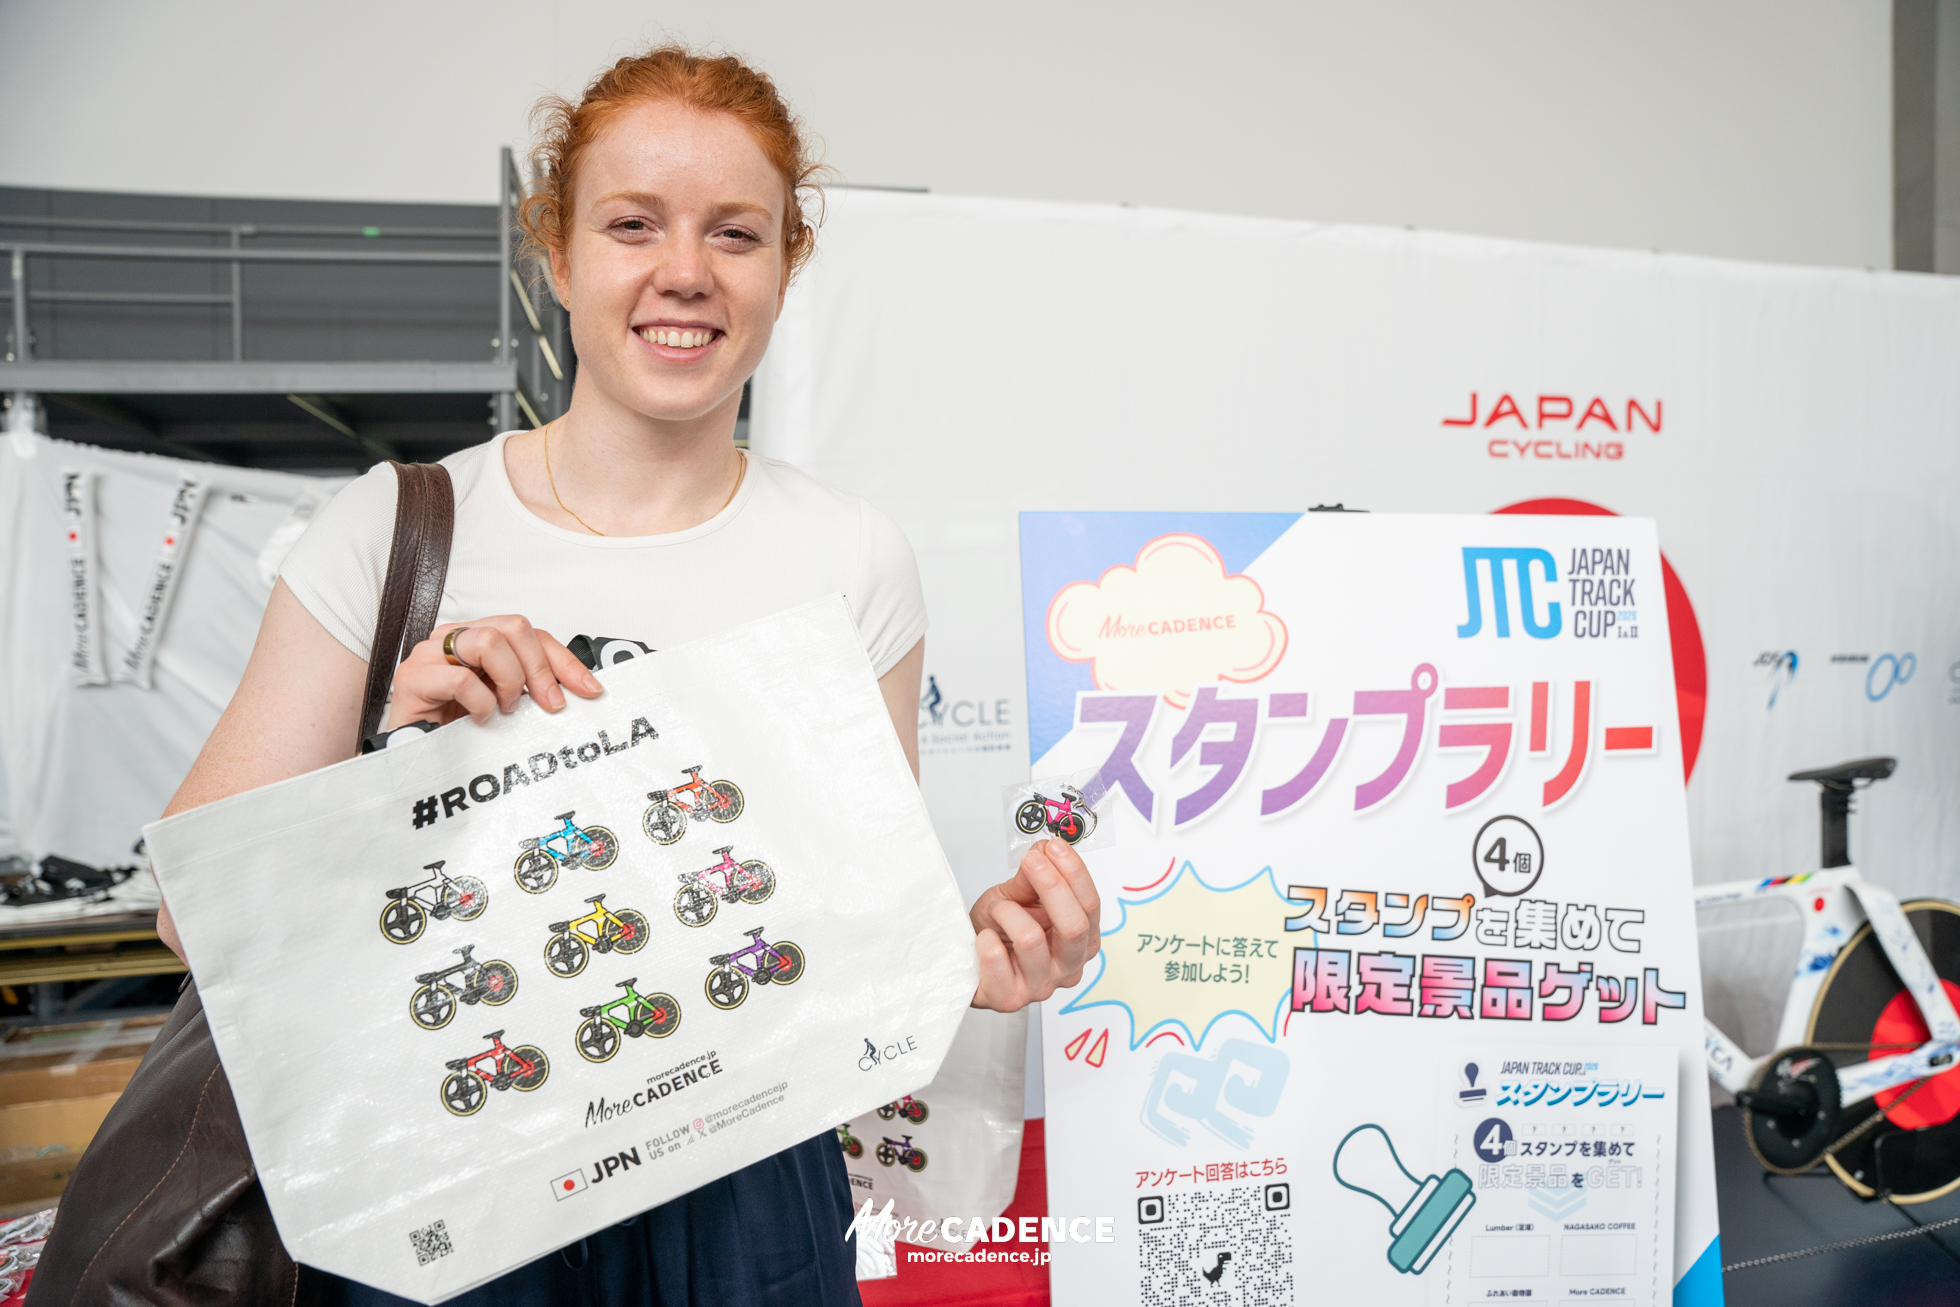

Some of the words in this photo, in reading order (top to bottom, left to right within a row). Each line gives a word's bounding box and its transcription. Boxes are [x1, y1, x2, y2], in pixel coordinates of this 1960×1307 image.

[1441, 392, 1662, 433] JAPAN
[1488, 438, 1624, 461] CYCLING
[1567, 548, 1630, 576] JAPAN
[1457, 547, 1563, 639] JTC
[1567, 578, 1636, 607] TRACK
[1574, 610, 1616, 638] CUP
[1079, 662, 1654, 827] スタンプラリー
[412, 717, 660, 830] #ROADtoLA
[1483, 837, 1532, 874] 4個
[1284, 884, 1645, 954] スタンプを集めて
[1136, 933, 1279, 959] アンケートに答えて
[1290, 946, 1686, 1026] 限定景品ゲット
[646, 1049, 717, 1085] morecadence.jp
[858, 1035, 918, 1071] CYCLE
[1499, 1061, 1529, 1075] JAPAN
[1531, 1062, 1562, 1075] TRACK
[1494, 1078, 1665, 1107] スタンプラリー
[645, 1124, 690, 1150] FOLLOW
[704, 1081, 789, 1124] @morecadencejp
[649, 1148, 665, 1160] US
[668, 1142, 682, 1153] on
[708, 1094, 785, 1135] @MoreCadence
[591, 1146, 642, 1184] JPN
[1520, 1140, 1636, 1157] スタンプを集めて
[1135, 1157, 1288, 1189] アンケート回答はこちら
[1607, 1222, 1636, 1230] COFFEE
[1589, 1287, 1626, 1296] CADENCE
